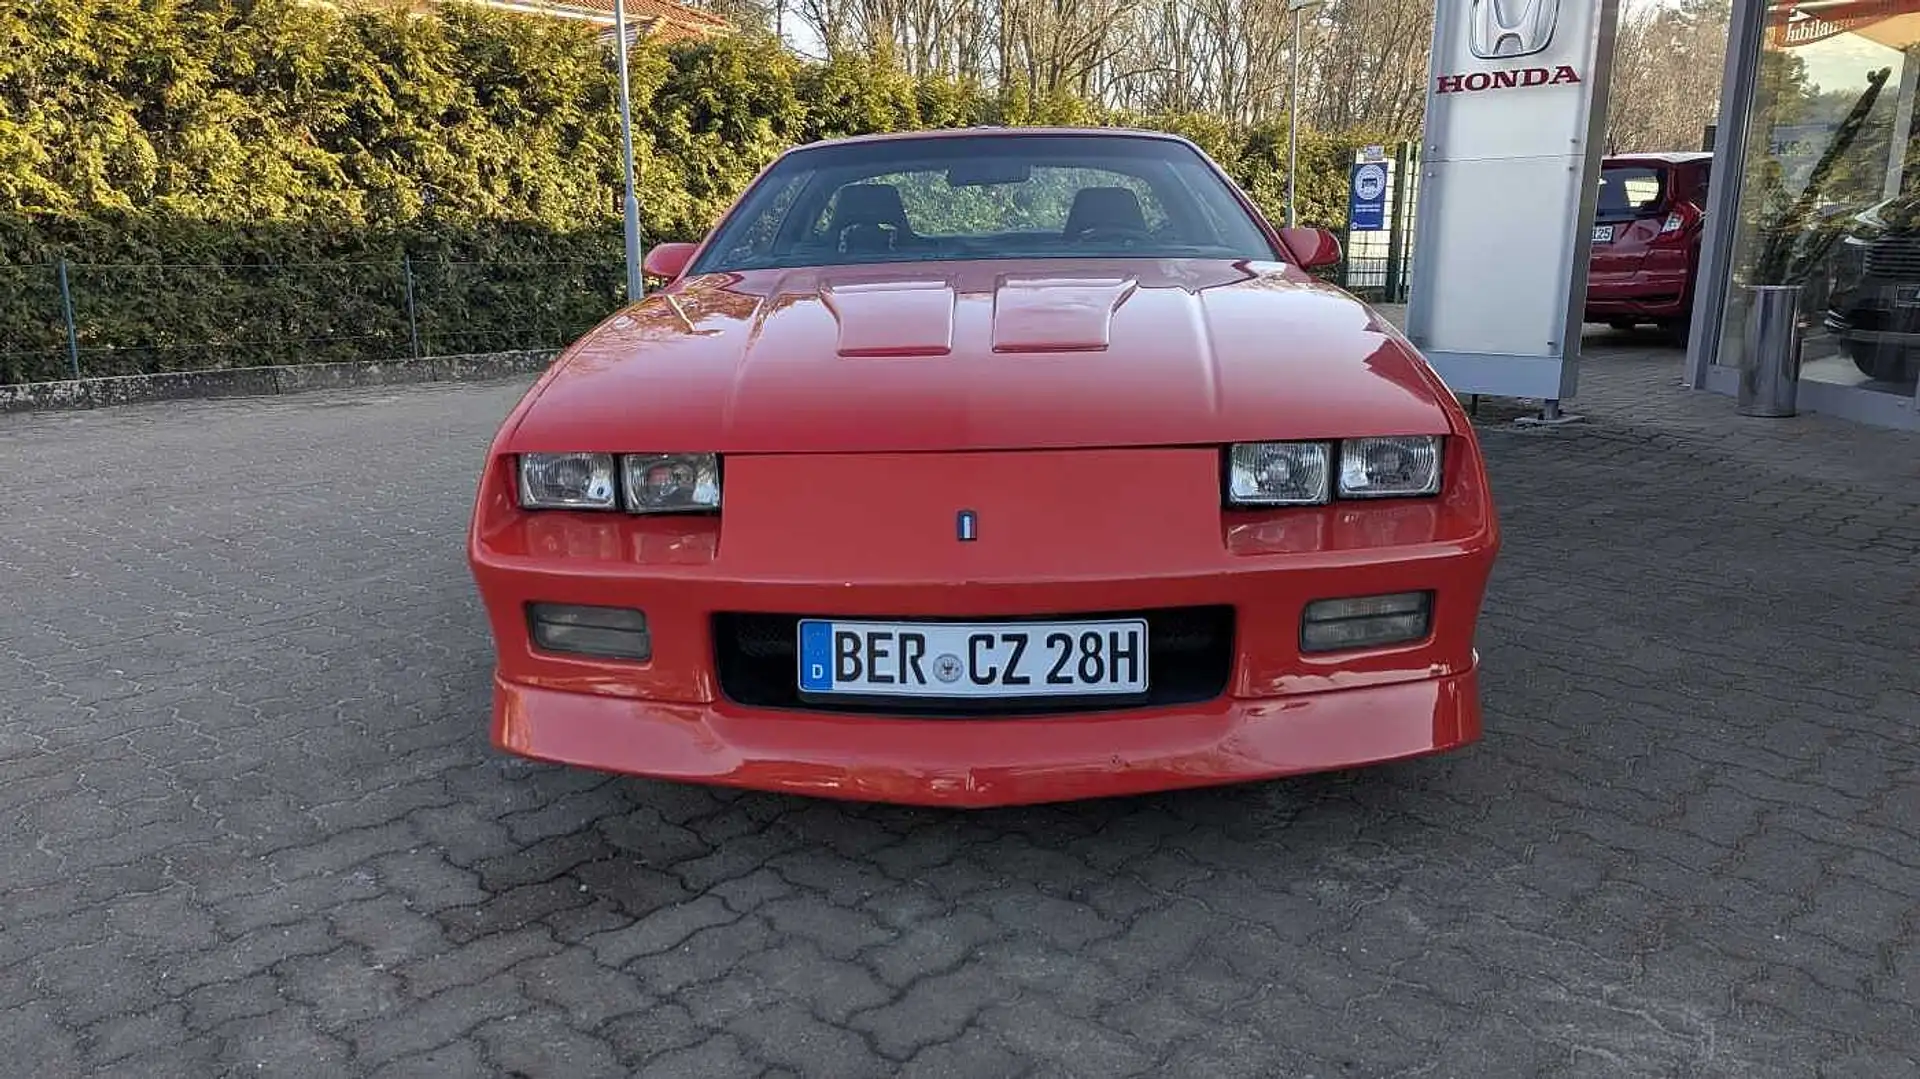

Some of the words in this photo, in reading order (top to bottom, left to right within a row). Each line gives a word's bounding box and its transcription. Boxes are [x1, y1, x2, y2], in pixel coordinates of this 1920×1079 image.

[1435, 65, 1581, 94] HONDA
[811, 663, 824, 679] D
[835, 631, 927, 684] BER
[968, 633, 1031, 686] CZ
[1046, 630, 1138, 684] 28H
